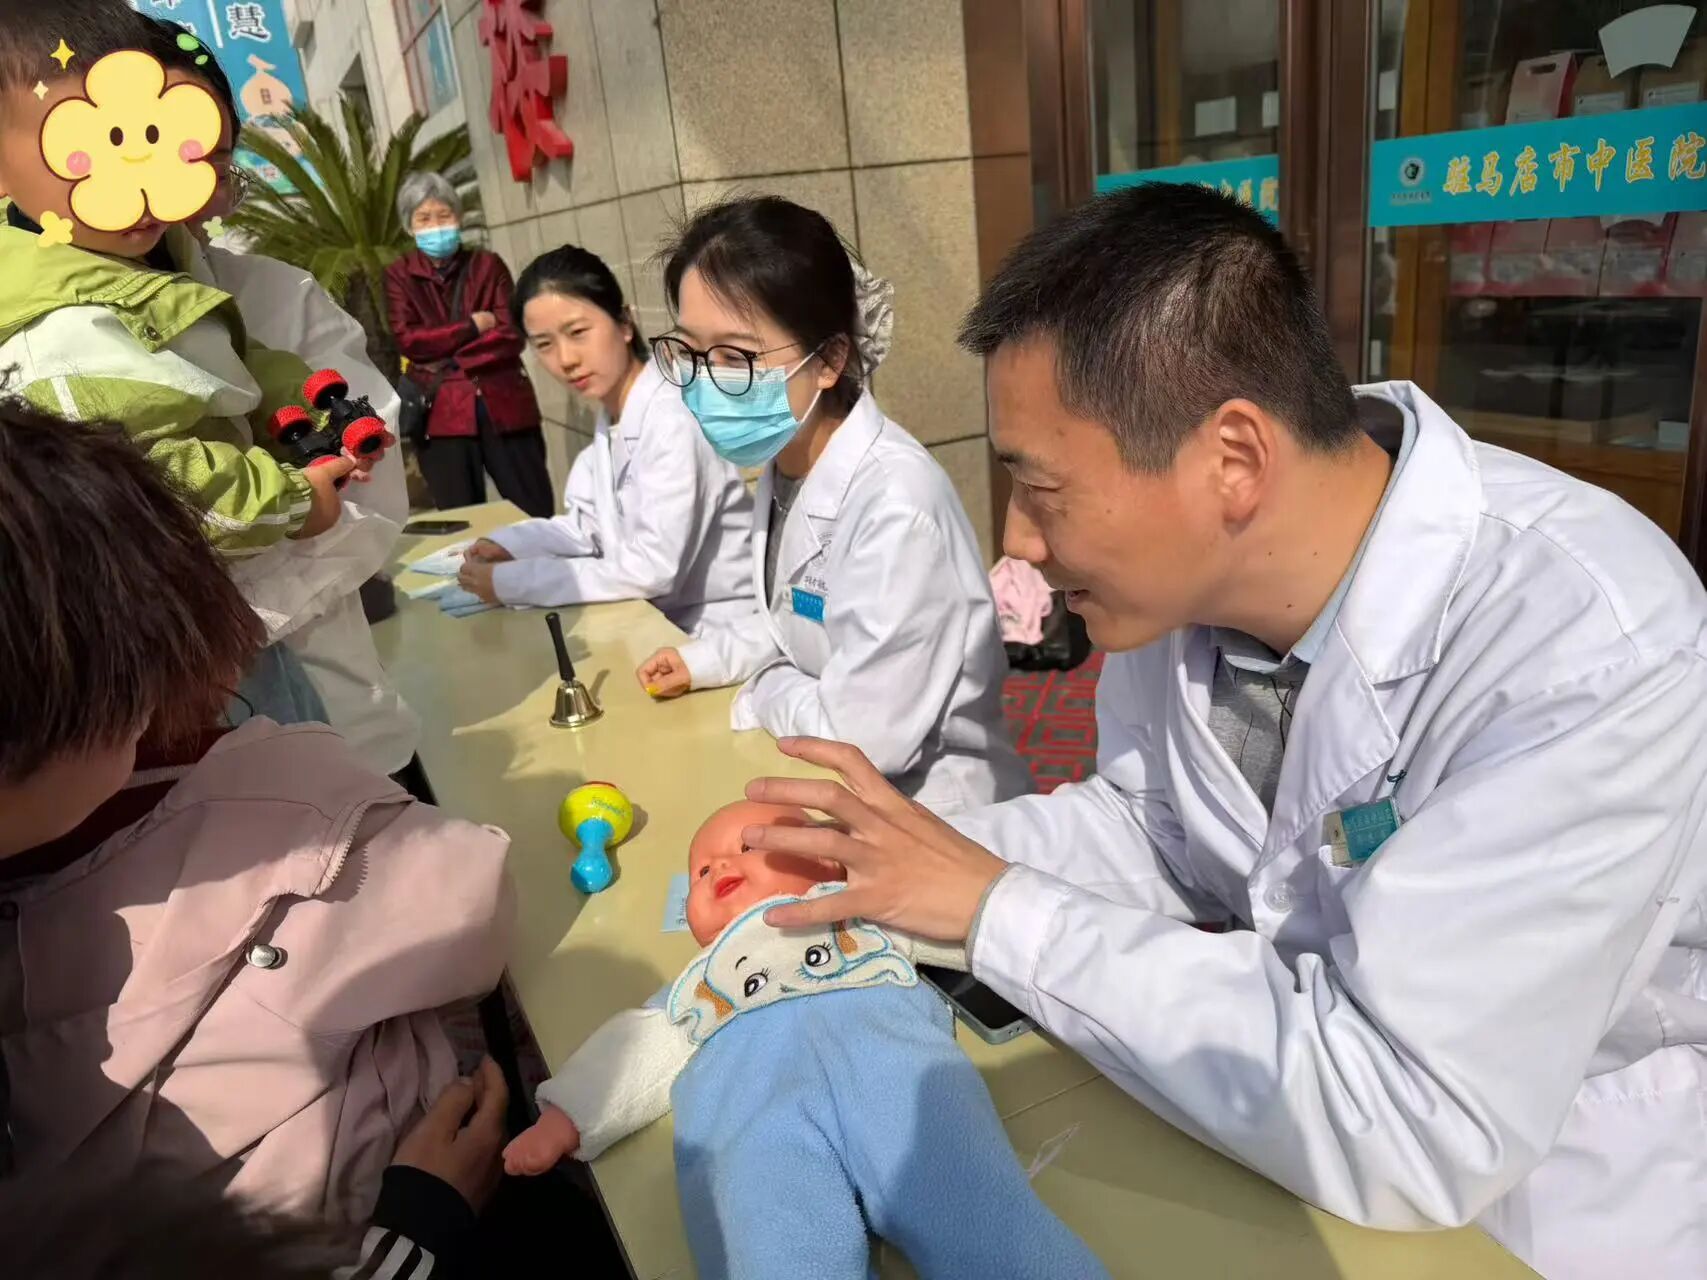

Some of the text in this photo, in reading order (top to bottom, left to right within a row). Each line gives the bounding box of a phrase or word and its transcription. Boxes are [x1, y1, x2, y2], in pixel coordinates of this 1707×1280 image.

[226, 3, 271, 42] 慧
[1443, 132, 1706, 197] 驻马店市中医院
